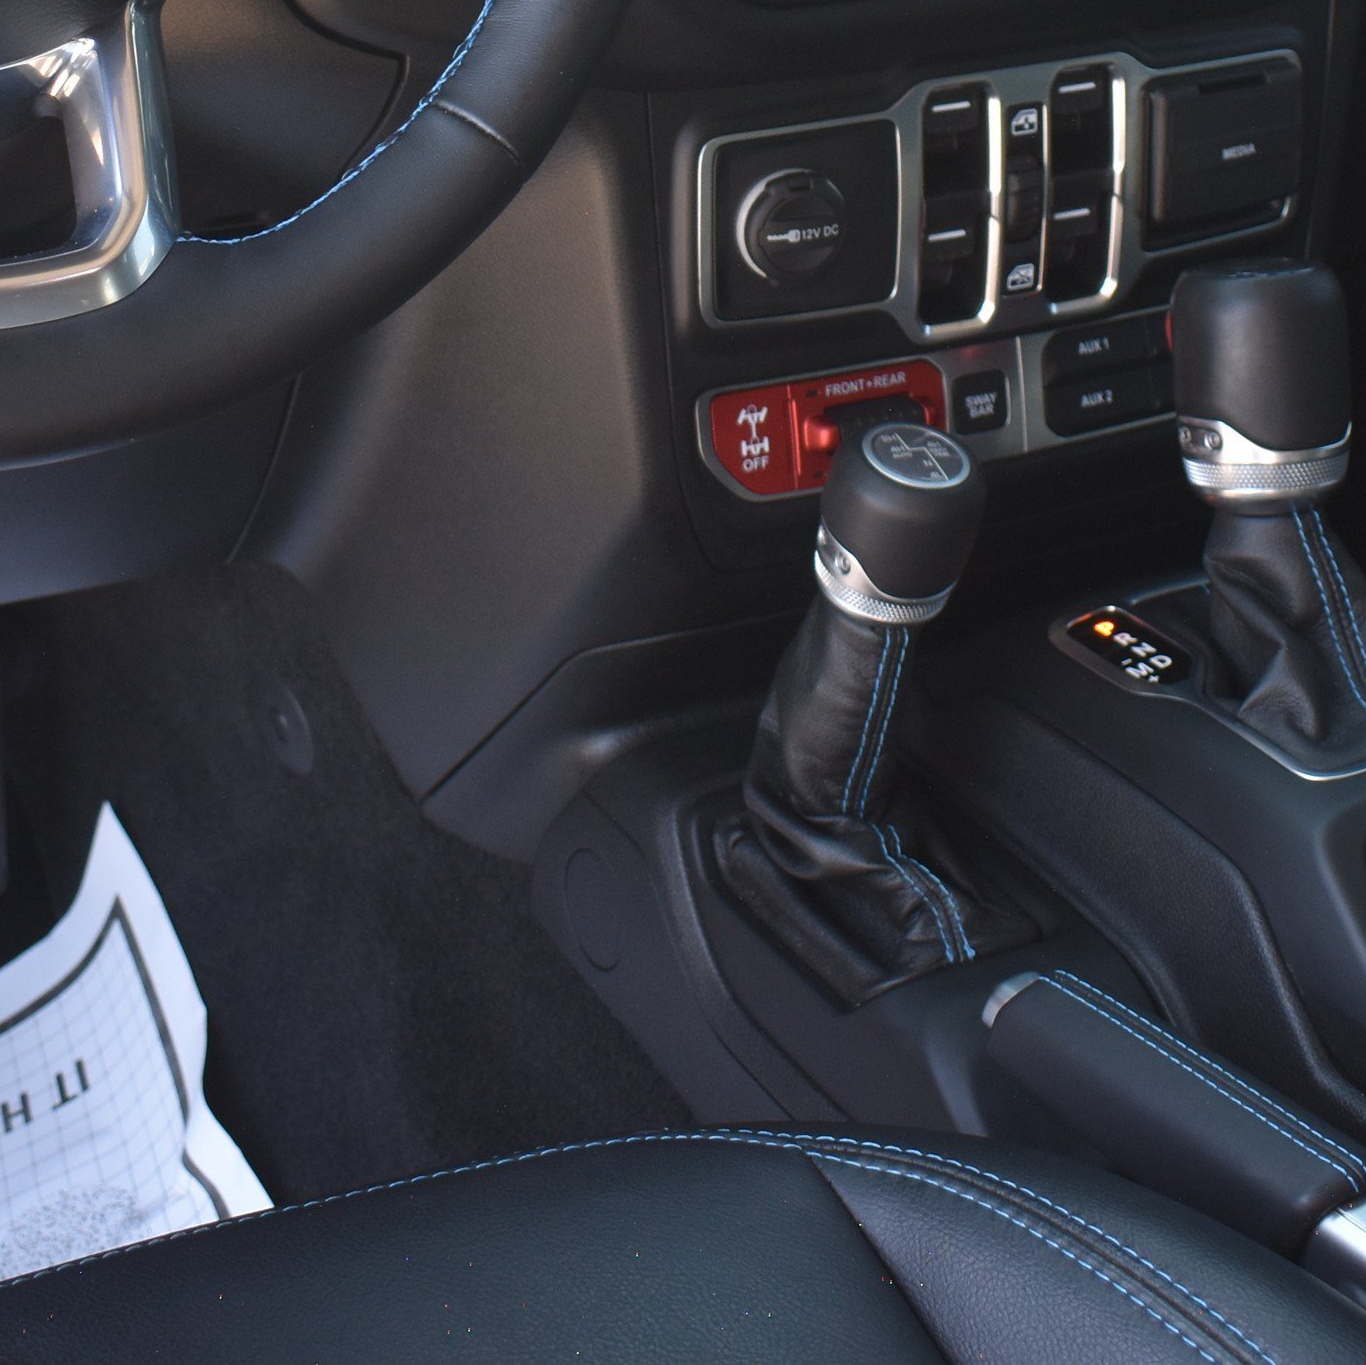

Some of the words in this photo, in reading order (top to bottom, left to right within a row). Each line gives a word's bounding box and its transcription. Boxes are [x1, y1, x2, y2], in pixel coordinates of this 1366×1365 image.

[1077, 338, 1103, 356] AUX
[965, 391, 998, 407] SWAY
[1080, 391, 1105, 408] AUX
[1104, 388, 1114, 404] 2
[970, 403, 996, 419] BAR
[742, 454, 770, 473] OFF
[1113, 632, 1138, 647] R
[1131, 641, 1157, 658] N
[1125, 661, 1154, 679] M
[1148, 654, 1173, 669] D
[52, 1057, 91, 1111] IT
